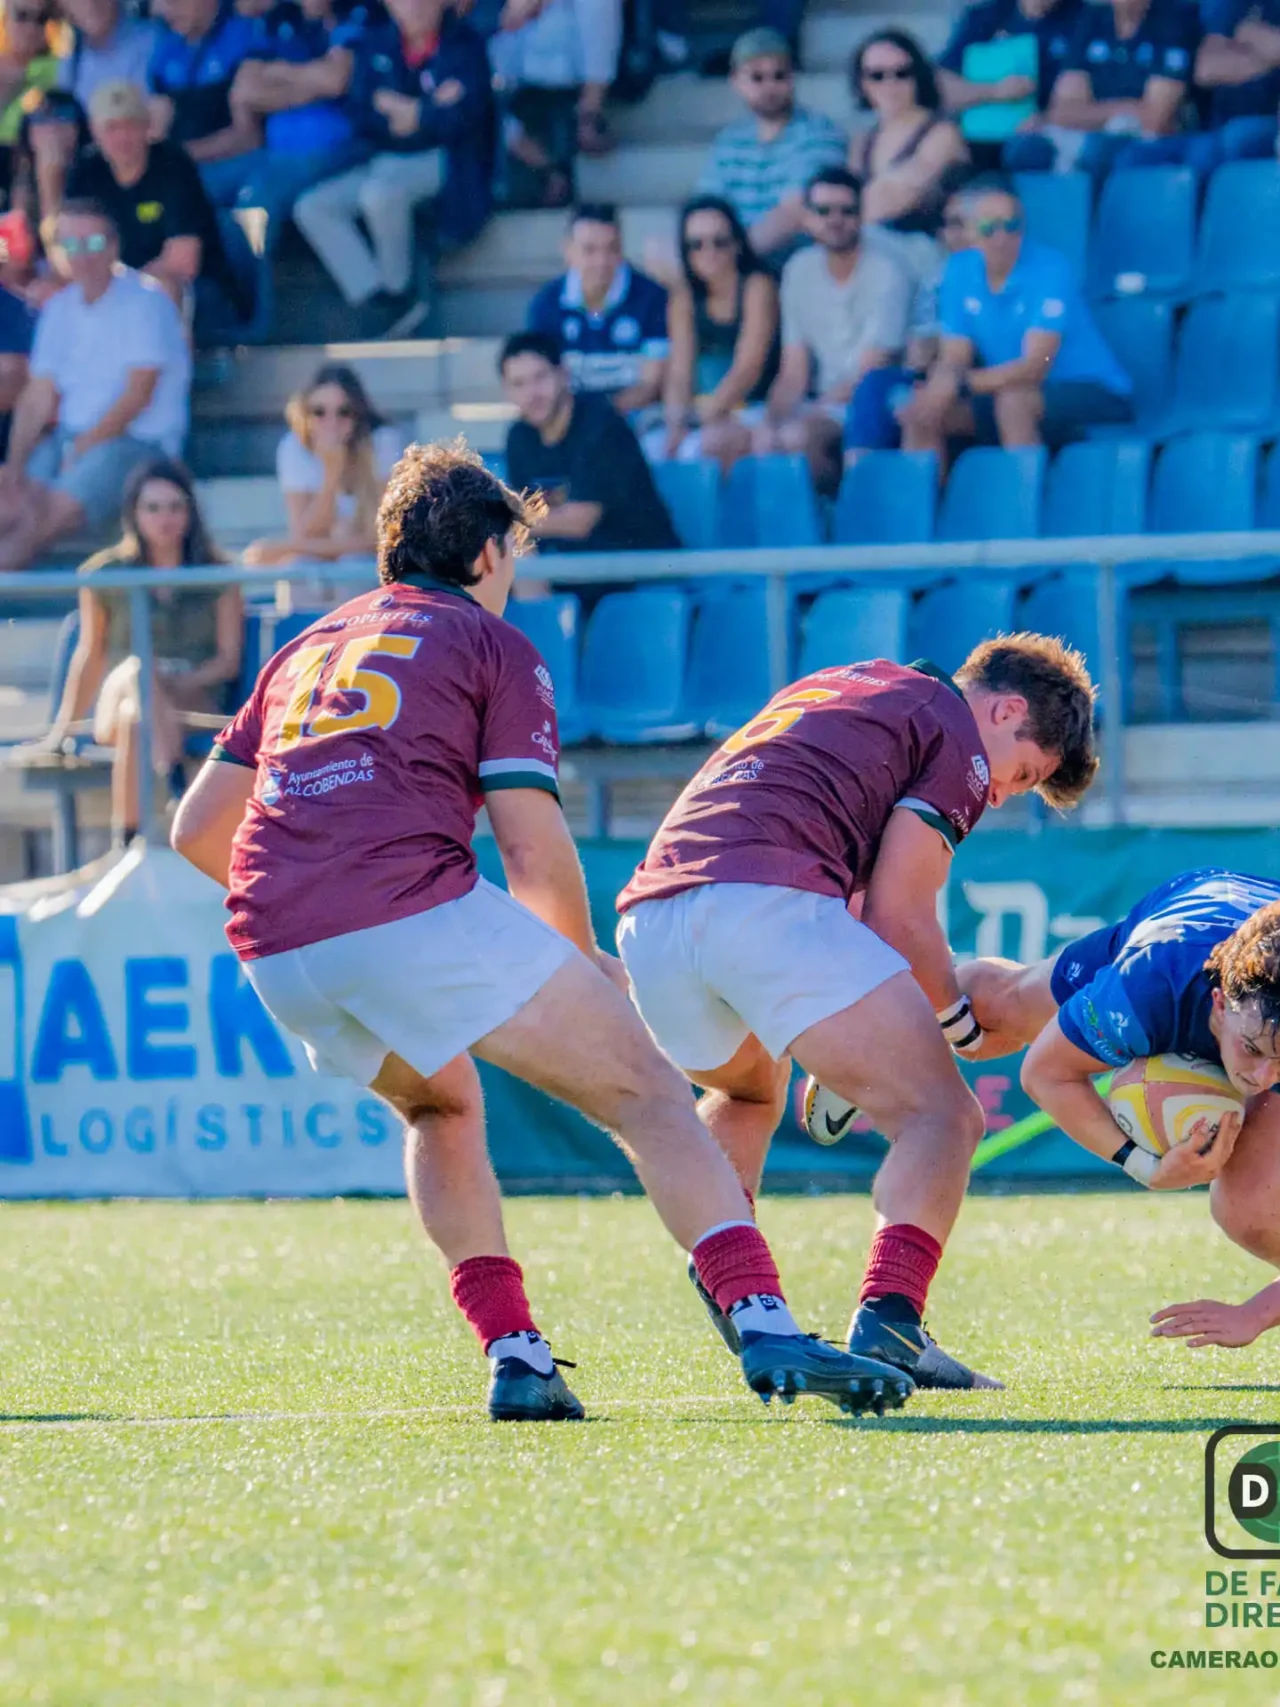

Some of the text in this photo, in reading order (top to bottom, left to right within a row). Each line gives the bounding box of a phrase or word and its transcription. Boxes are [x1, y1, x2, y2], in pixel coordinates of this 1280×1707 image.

[278, 632, 424, 751] 15
[284, 769, 375, 797] ALCOBENDAS
[287, 753, 375, 786] Ayuntamiento de
